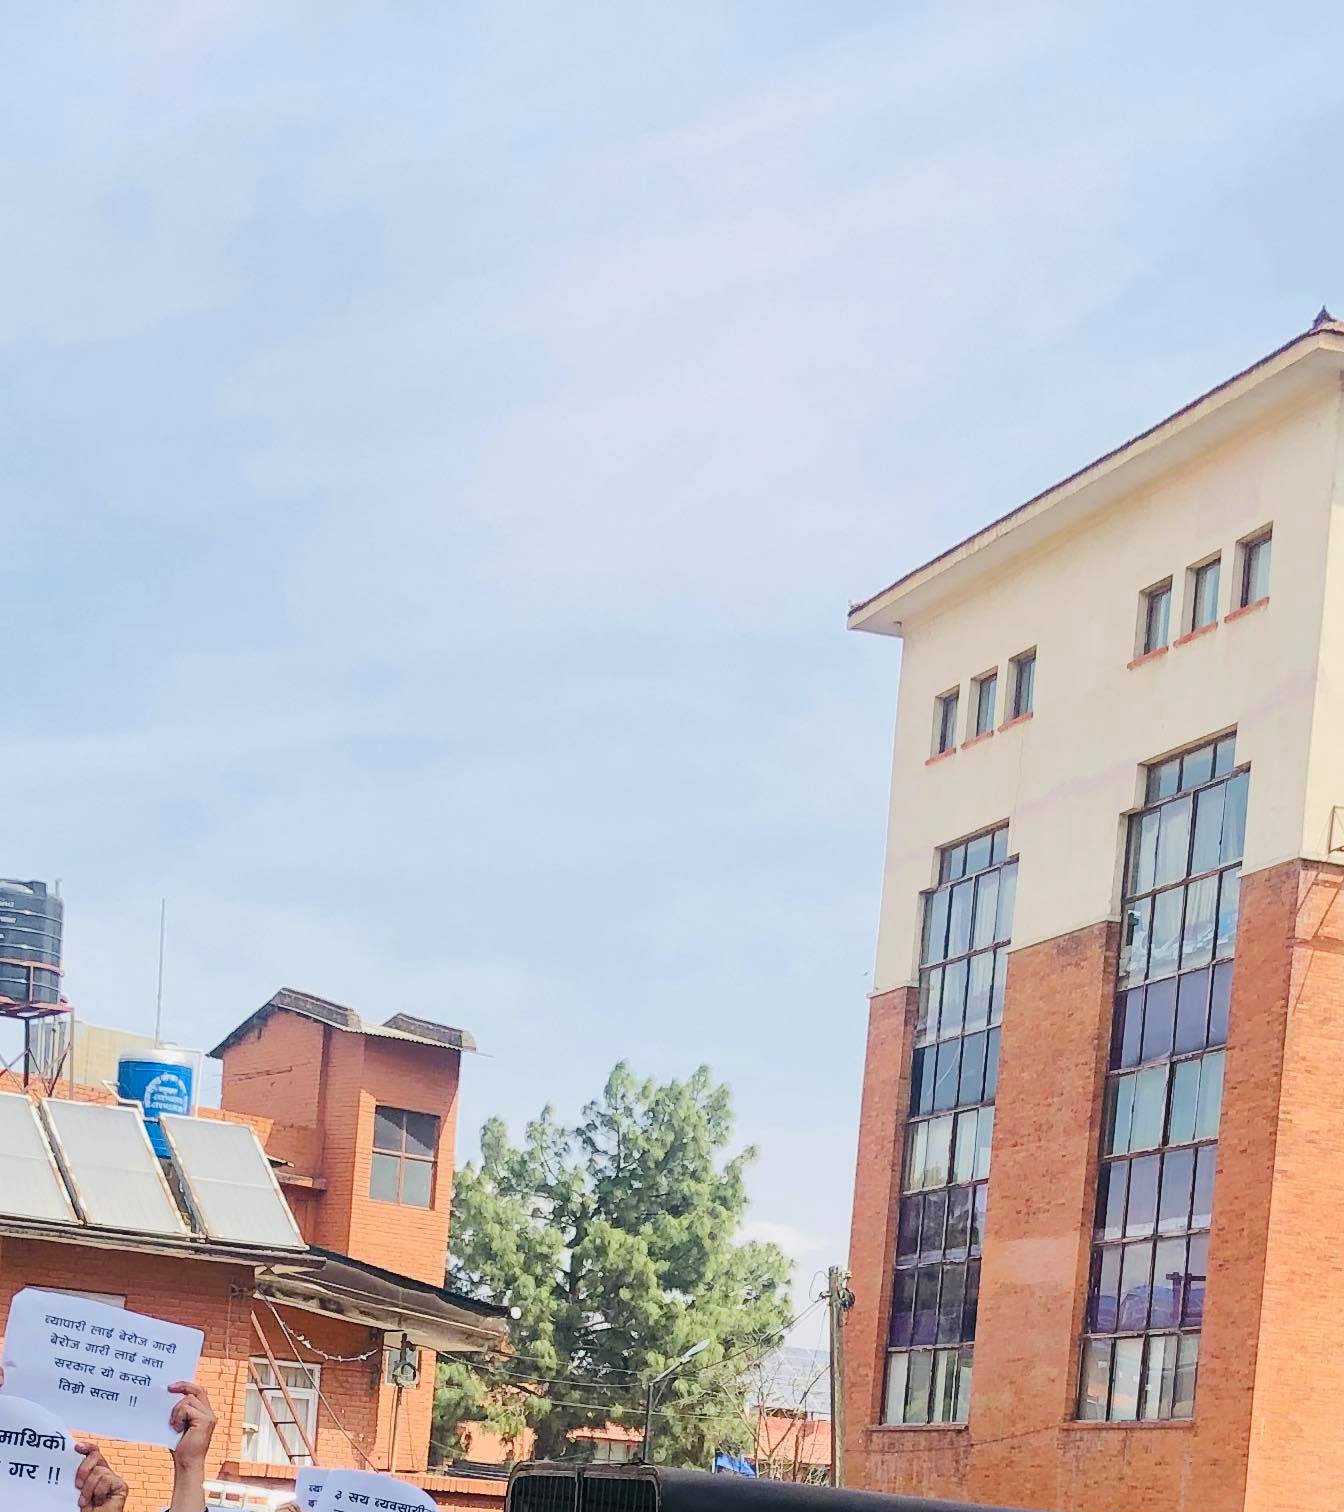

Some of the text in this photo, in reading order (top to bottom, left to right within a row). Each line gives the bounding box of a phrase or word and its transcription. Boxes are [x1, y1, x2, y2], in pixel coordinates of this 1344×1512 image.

[55, 1357, 95, 1375] सरकार
[9, 1462, 39, 1480] गर
[348, 1492, 369, 1505] सय
